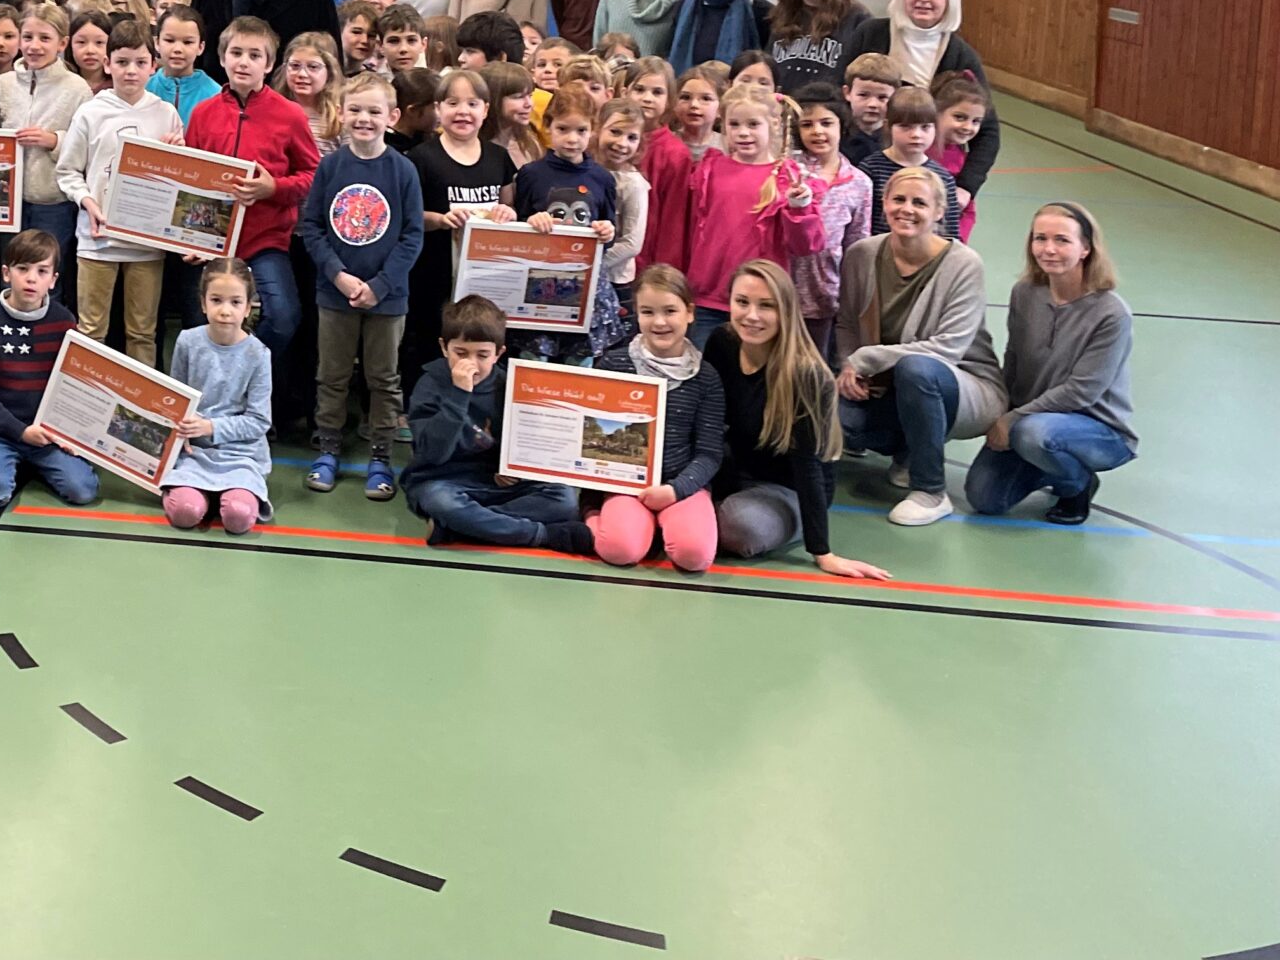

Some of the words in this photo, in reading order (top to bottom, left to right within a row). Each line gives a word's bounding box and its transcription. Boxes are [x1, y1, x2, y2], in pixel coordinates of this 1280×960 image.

[126, 156, 139, 166] Die
[448, 186, 490, 202] ALWAYS
[474, 242, 486, 250] Die
[68, 356, 82, 368] Die
[520, 382, 534, 393] Die
